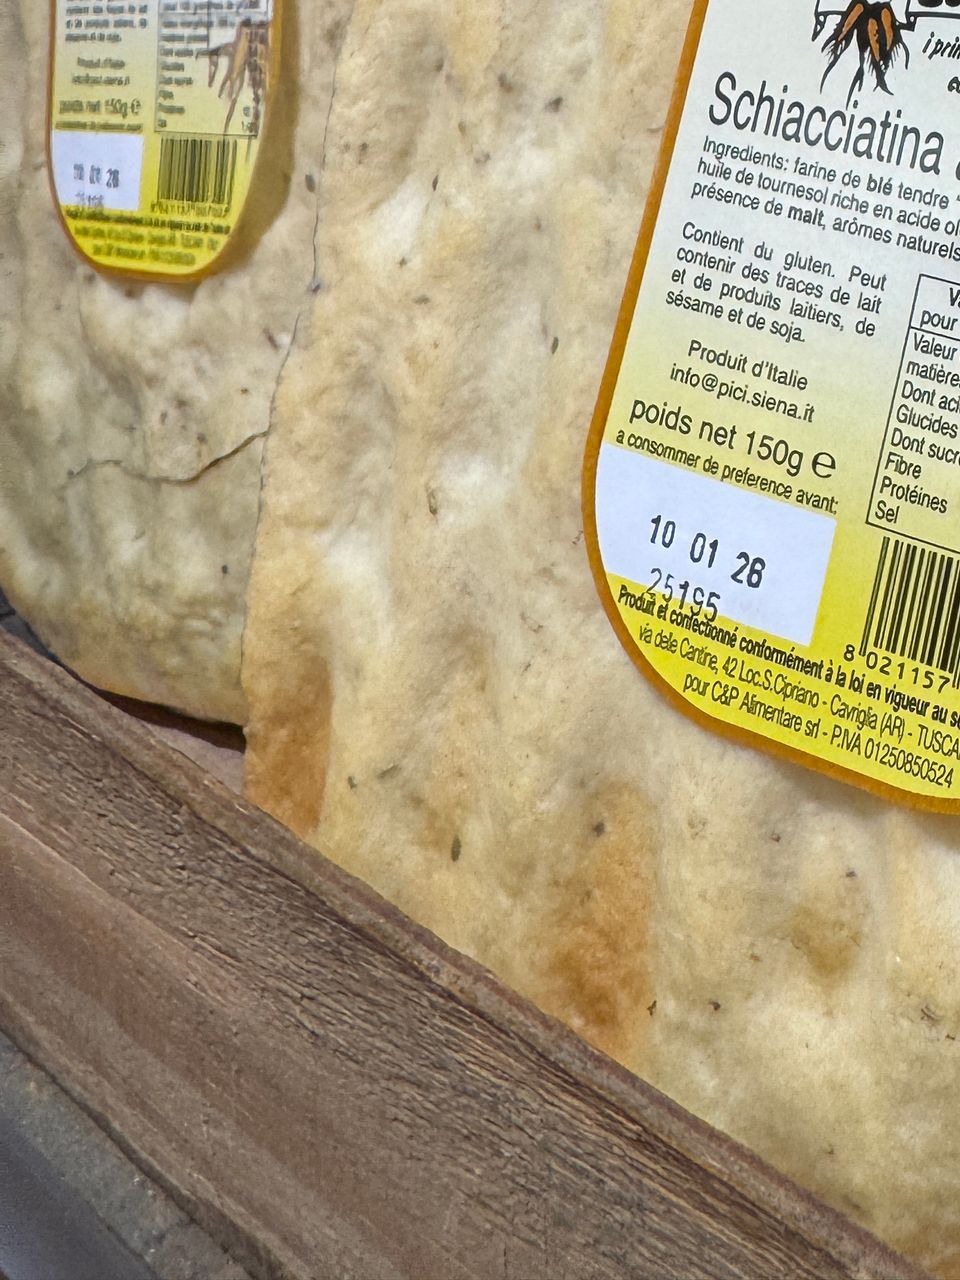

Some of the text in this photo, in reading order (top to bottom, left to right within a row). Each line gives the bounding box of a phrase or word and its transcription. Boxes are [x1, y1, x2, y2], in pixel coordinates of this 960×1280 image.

[709, 71, 944, 174] Schiacciatina
[697, 157, 731, 180] huile
[735, 167, 753, 186] de
[758, 172, 828, 204] tournesol
[831, 188, 869, 214] riche
[874, 203, 892, 220] en
[897, 207, 940, 232] acide
[703, 136, 789, 170] Ingredients:
[794, 157, 836, 182] farine
[842, 169, 861, 188] de
[867, 174, 892, 195] blé
[898, 182, 949, 209] tendre
[691, 182, 760, 210] présence
[764, 198, 782, 216] de
[787, 206, 826, 230] malt,
[832, 218, 892, 244] arômes
[677, 247, 882, 315] contenir des traces de lait
[682, 221, 887, 291] Contient du gluten. Peut
[665, 290, 806, 344] sésame et de soja.
[671, 267, 876, 337] et de produits laitiers, de
[920, 310, 960, 332] pour
[688, 339, 748, 374] Produit
[912, 333, 958, 362] Valeur
[670, 363, 815, 423] info@pici.siena.it
[896, 403, 958, 439] Glucides
[900, 379, 936, 406] Dont
[616, 428, 625, 444] a
[627, 433, 701, 469] consommer
[702, 455, 719, 475] de
[721, 464, 793, 500] preference
[629, 398, 692, 435] poids
[698, 420, 737, 450] net
[746, 430, 804, 478] 150g
[885, 452, 922, 479] Fibre
[890, 427, 927, 451] Dont
[875, 500, 900, 524] Sel
[879, 475, 947, 514] Protéines
[650, 515, 676, 548] 10
[689, 533, 719, 568] 01
[618, 584, 656, 616] Produit
[657, 603, 668, 621] et
[670, 609, 738, 648] confectionné
[740, 635, 824, 680] conformément
[824, 659, 833, 683] à
[835, 665, 846, 687] la
[849, 669, 865, 694] loi
[866, 681, 881, 700] en
[885, 685, 930, 717] vigueur
[932, 704, 948, 722] au
[639, 623, 653, 644] via
[722, 656, 738, 678] 42
[880, 712, 905, 743] (AR)
[843, 644, 855, 662] 8
[866, 651, 950, 693] 021157
[683, 673, 710, 697] pour
[711, 681, 739, 706] C&P
[739, 691, 802, 732] Alimentare
[805, 718, 821, 739] srl
[864, 738, 954, 788] 01250850524
